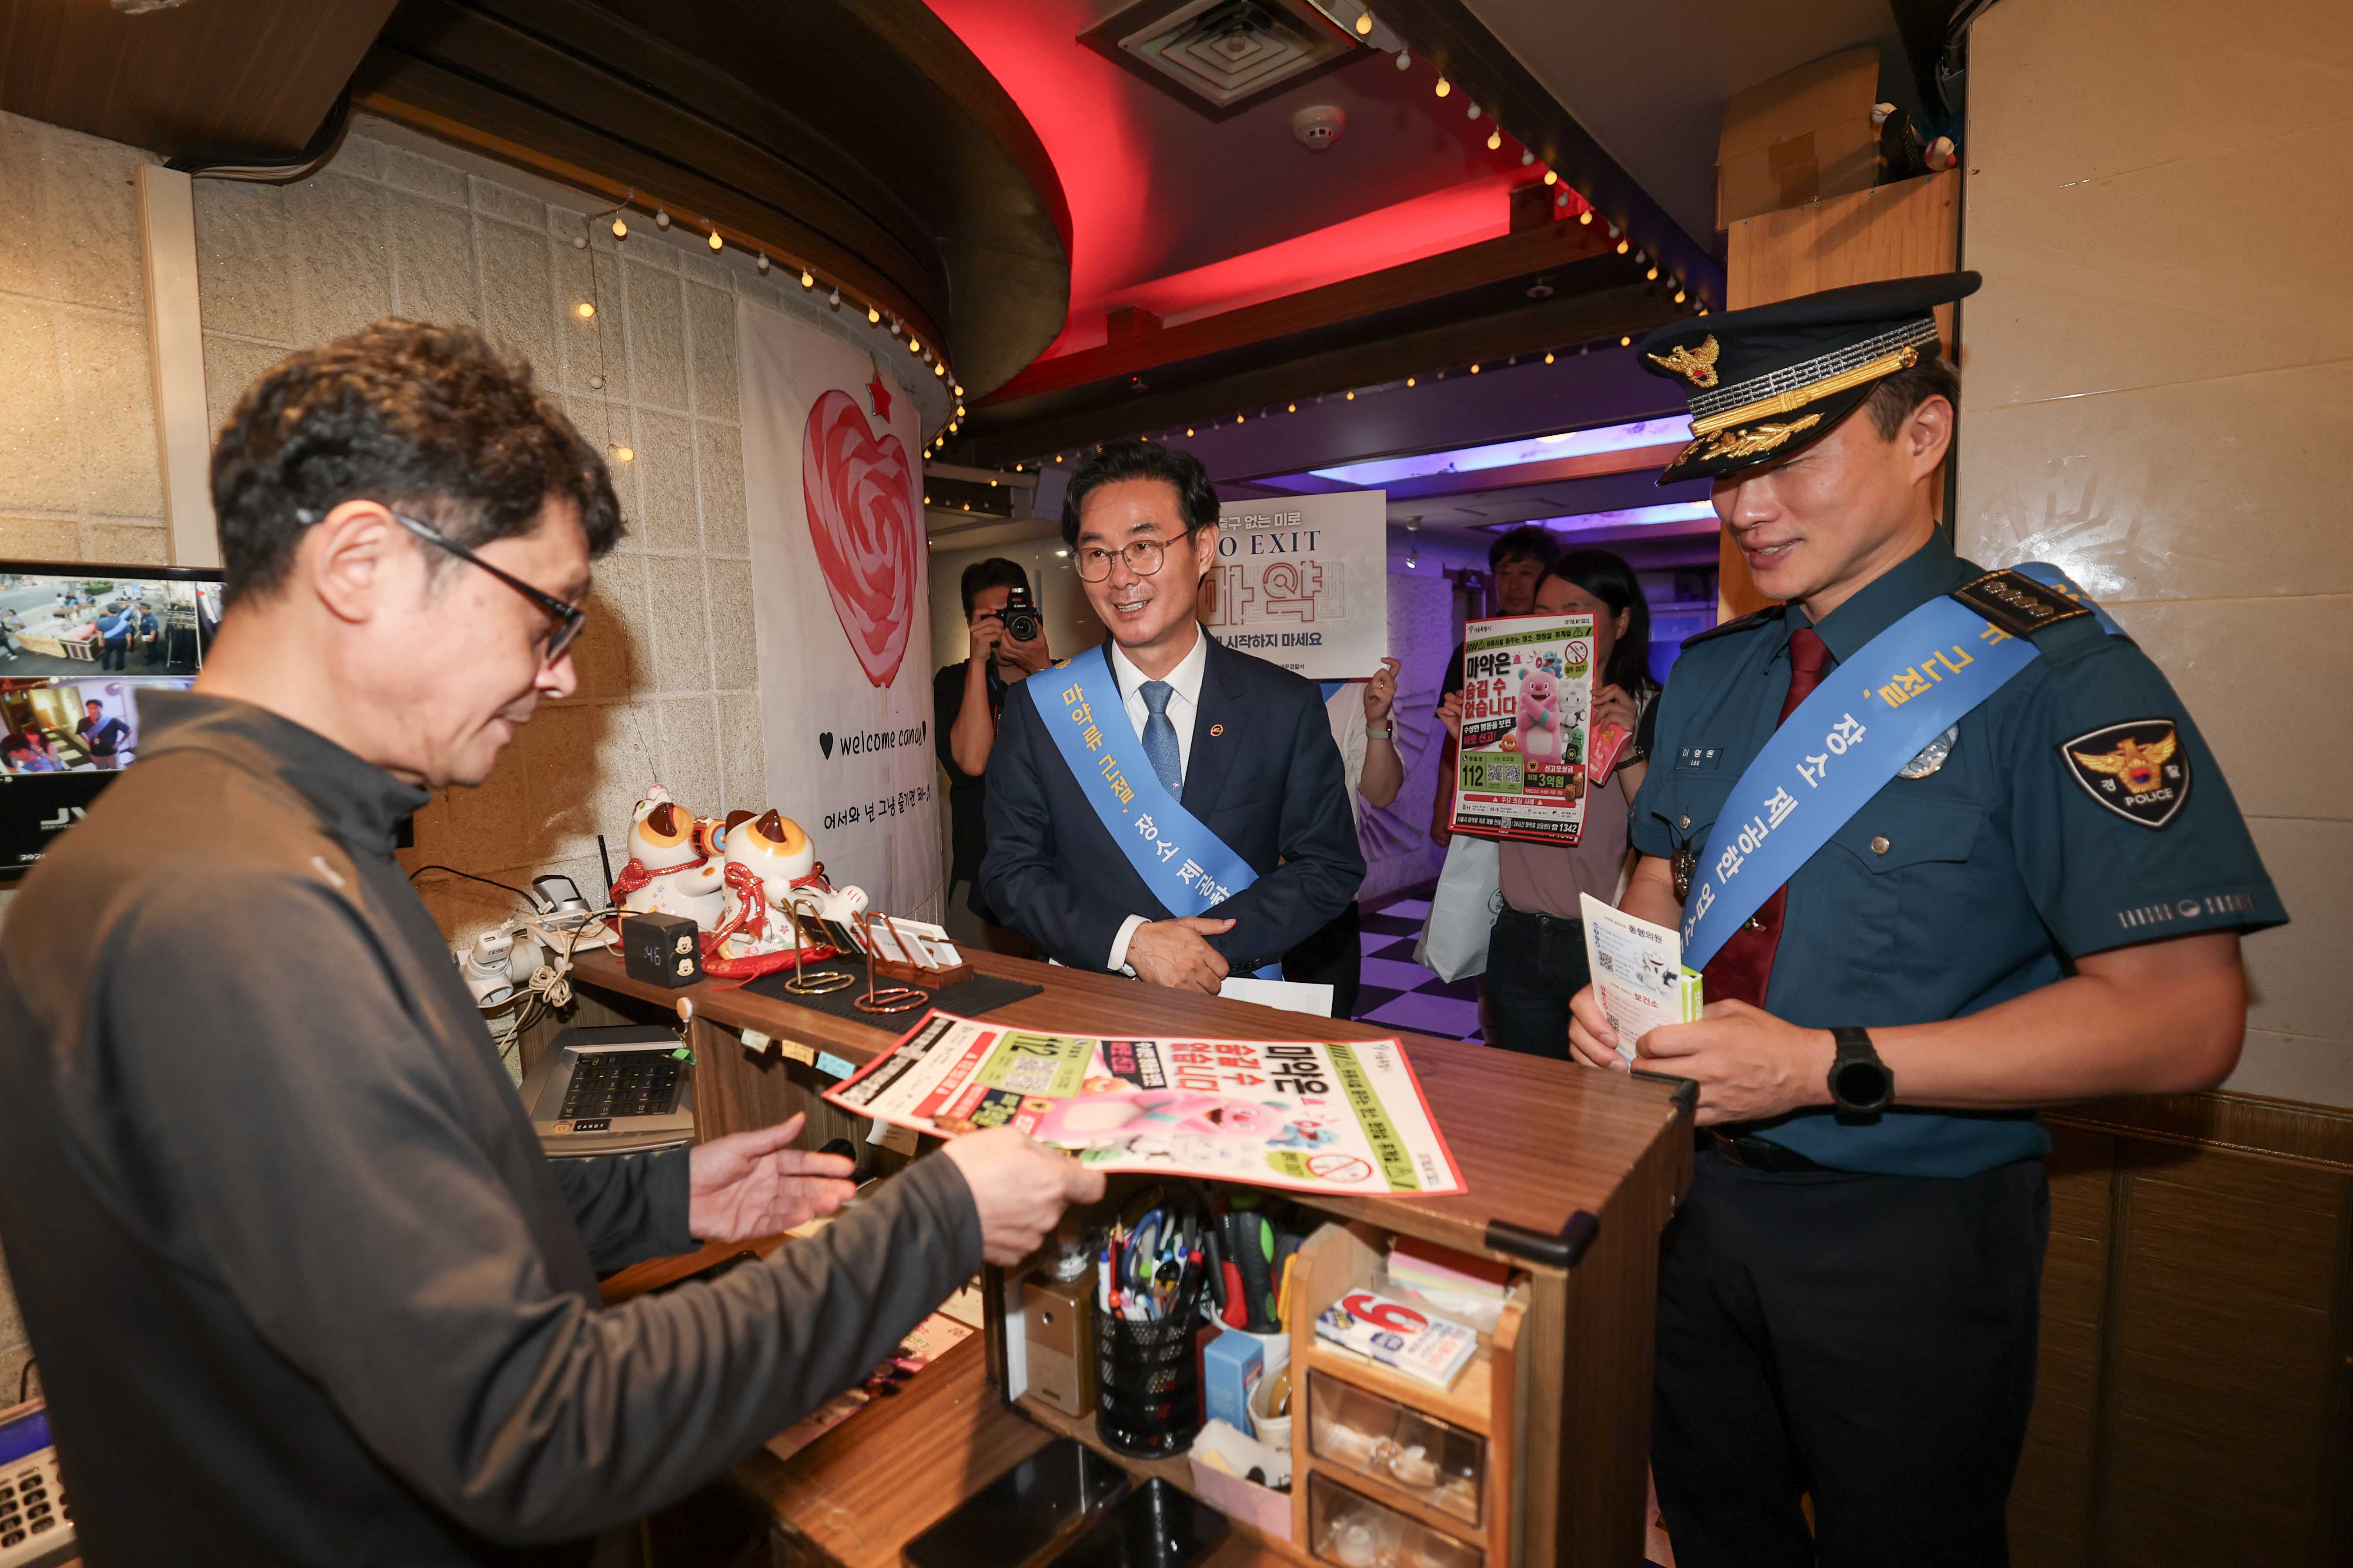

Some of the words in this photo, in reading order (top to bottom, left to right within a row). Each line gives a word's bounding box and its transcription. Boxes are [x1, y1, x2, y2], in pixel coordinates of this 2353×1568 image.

[1244, 514, 1271, 529] 없는
[1274, 511, 1302, 527] 미로
[1219, 536, 1237, 557] O
[1250, 530, 1321, 555] EXIT
[1226, 634, 1278, 648] 시작하지
[1282, 632, 1323, 647] 마세요
[1467, 652, 1511, 679] 마약은
[1466, 679, 1488, 700] 숨길
[1493, 677, 1506, 696] 수
[1464, 696, 1517, 720] 없습니다
[1464, 724, 1480, 734] 수상한
[1481, 721, 1498, 731] 행동을
[1499, 718, 1511, 728] 보면
[840, 731, 895, 756] welcome
[899, 727, 922, 747] candy
[1795, 712, 1868, 789] 장소
[1062, 682, 1104, 752] 마약류
[1134, 812, 1180, 864] 장소
[1462, 765, 1484, 787] 112
[1538, 773, 1564, 788] 3억원
[824, 806, 860, 830] 어서와
[878, 796, 895, 817] 그냥
[897, 788, 916, 814] 즐기면
[2124, 787, 2176, 807] POLICE
[1560, 823, 1577, 833] 1342
[1715, 786, 1799, 886] 제공한
[1681, 883, 1716, 955] 업소
[1628, 924, 1663, 944] 동행의원
[1634, 993, 1660, 1009] 보건소
[1171, 1042, 1220, 1092] 없습니다
[1214, 1044, 1262, 1069] 숨길
[1222, 1073, 1267, 1085] 수
[1264, 1046, 1330, 1094] 마약은
[1342, 1294, 1429, 1334] 6
